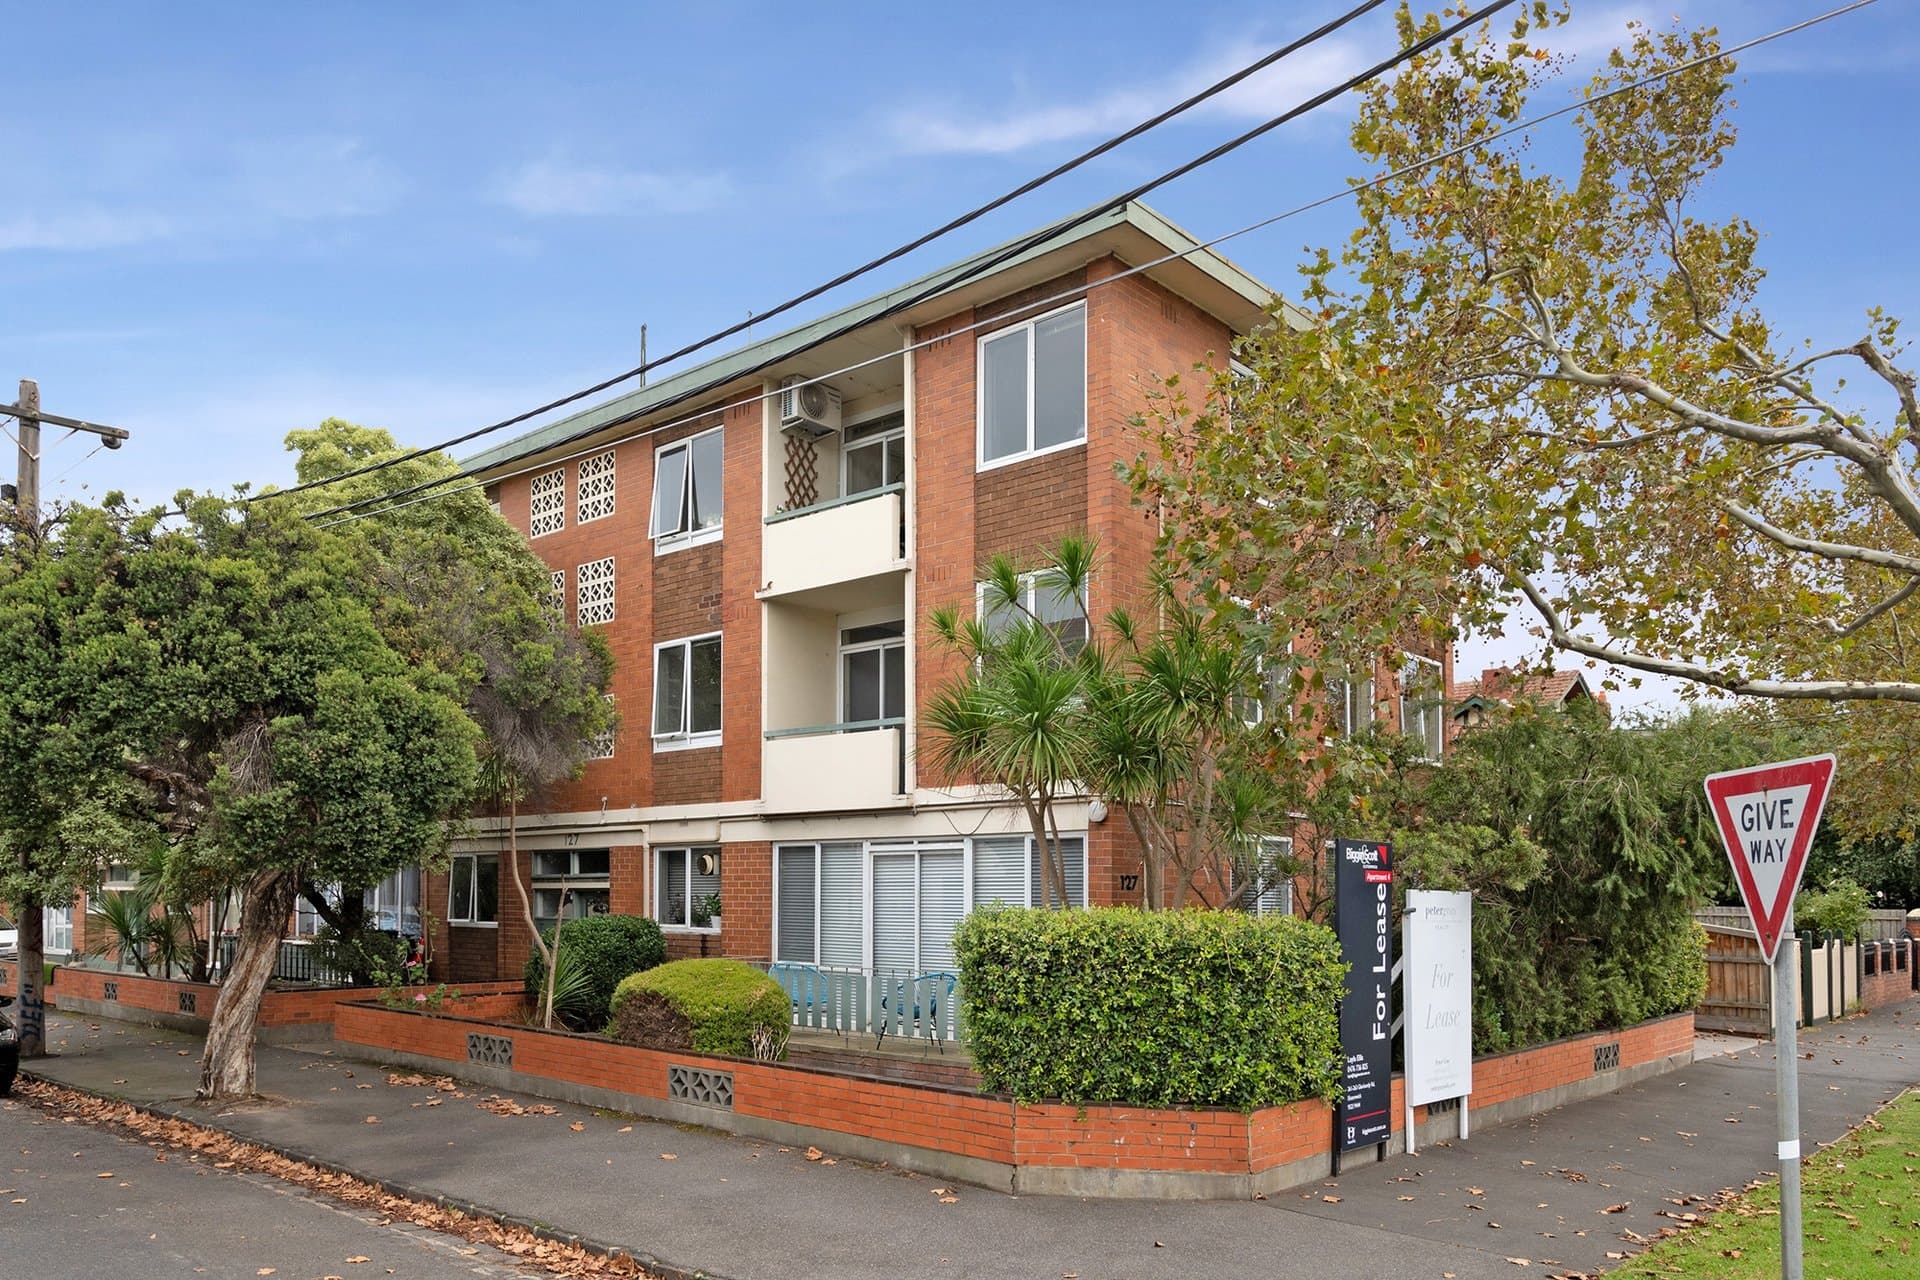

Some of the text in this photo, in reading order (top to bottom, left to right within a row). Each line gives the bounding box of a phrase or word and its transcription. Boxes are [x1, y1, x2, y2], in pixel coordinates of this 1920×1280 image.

[1741, 798, 1794, 832] GIVE
[564, 833, 579, 846] 127
[1750, 838, 1787, 864] WAY
[1120, 875, 1138, 890] 127
[1373, 883, 1387, 1041] For Lease
[1431, 963, 1454, 989] For
[1425, 1003, 1461, 1030] Lease
